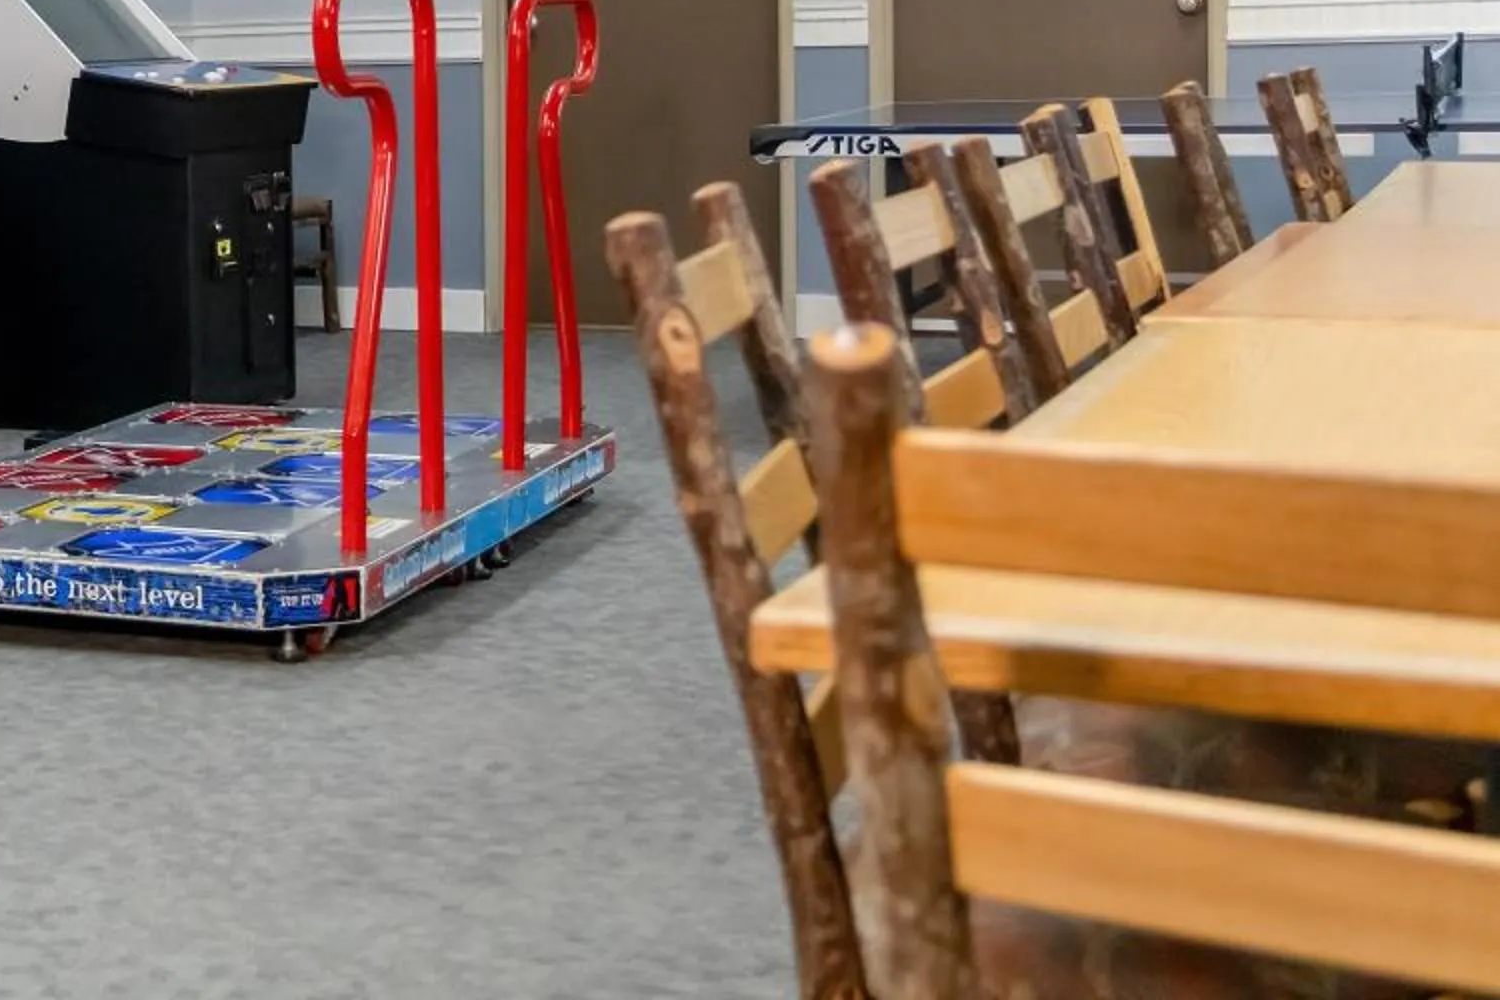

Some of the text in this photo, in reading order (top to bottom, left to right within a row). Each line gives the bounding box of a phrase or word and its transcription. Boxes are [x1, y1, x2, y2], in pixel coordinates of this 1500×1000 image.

[809, 135, 901, 155] STIGA
[15, 572, 57, 598] the
[67, 579, 126, 604] next
[139, 581, 203, 610] level
